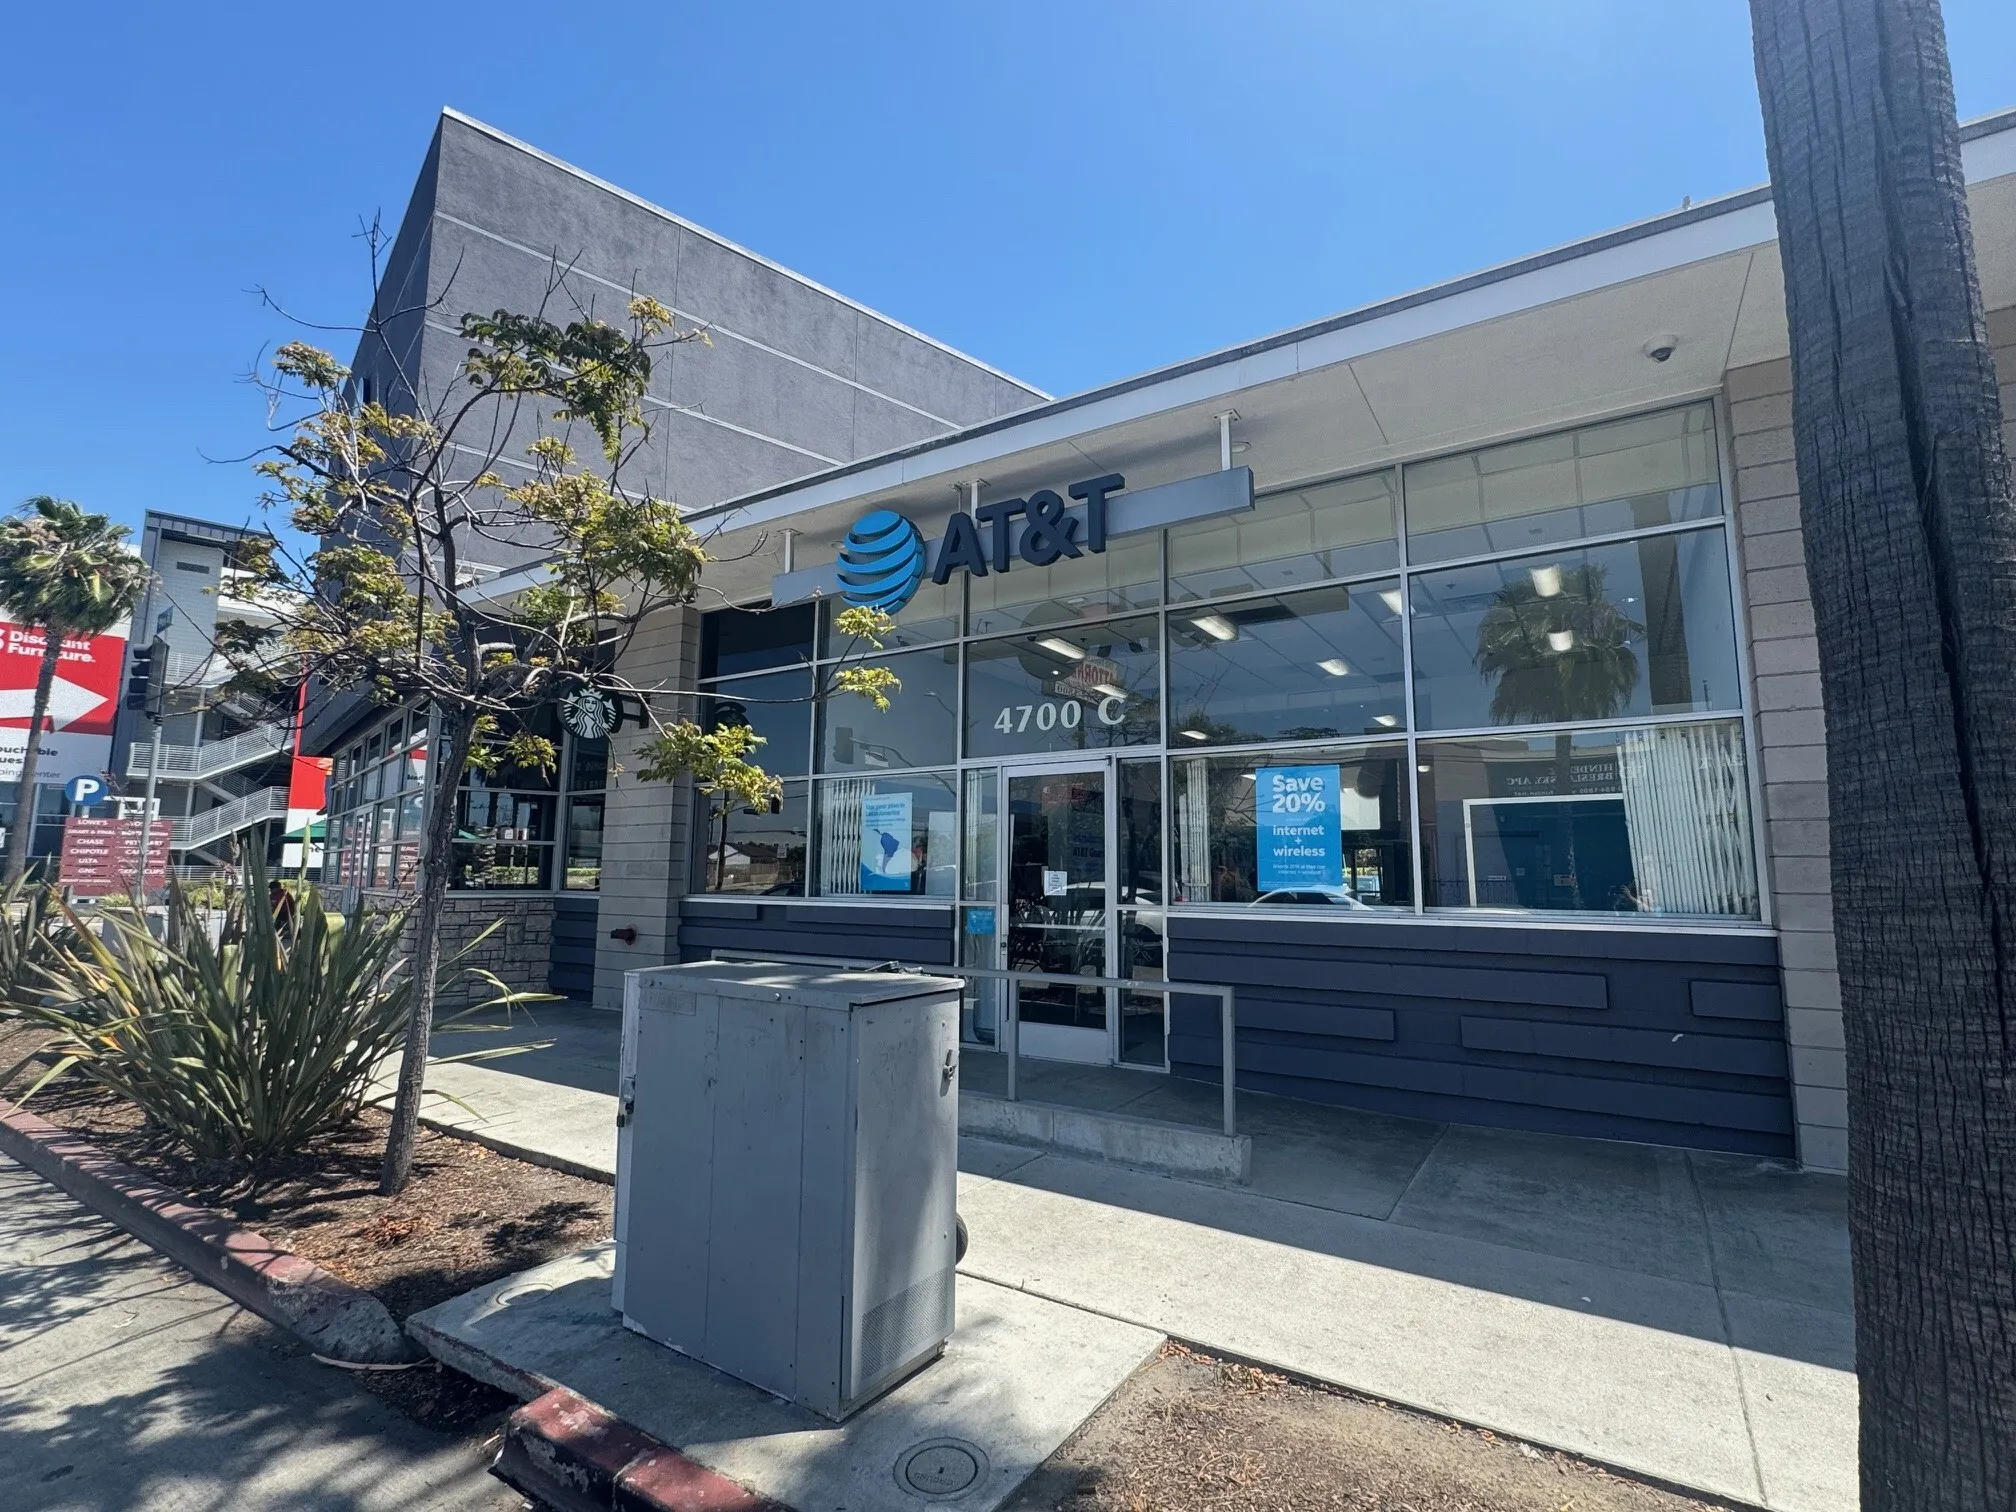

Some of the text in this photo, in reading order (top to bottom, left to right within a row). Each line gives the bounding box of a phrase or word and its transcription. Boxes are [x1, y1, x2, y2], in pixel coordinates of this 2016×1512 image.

[932, 473, 1126, 585] AT&T
[9, 630, 91, 650] Discunt
[994, 696, 1126, 734] 4700 C
[75, 779, 100, 801] P
[1273, 775, 1324, 792] Save
[1273, 793, 1326, 813] 20%
[1273, 825, 1324, 835] internet
[1273, 845, 1325, 857] wireless
